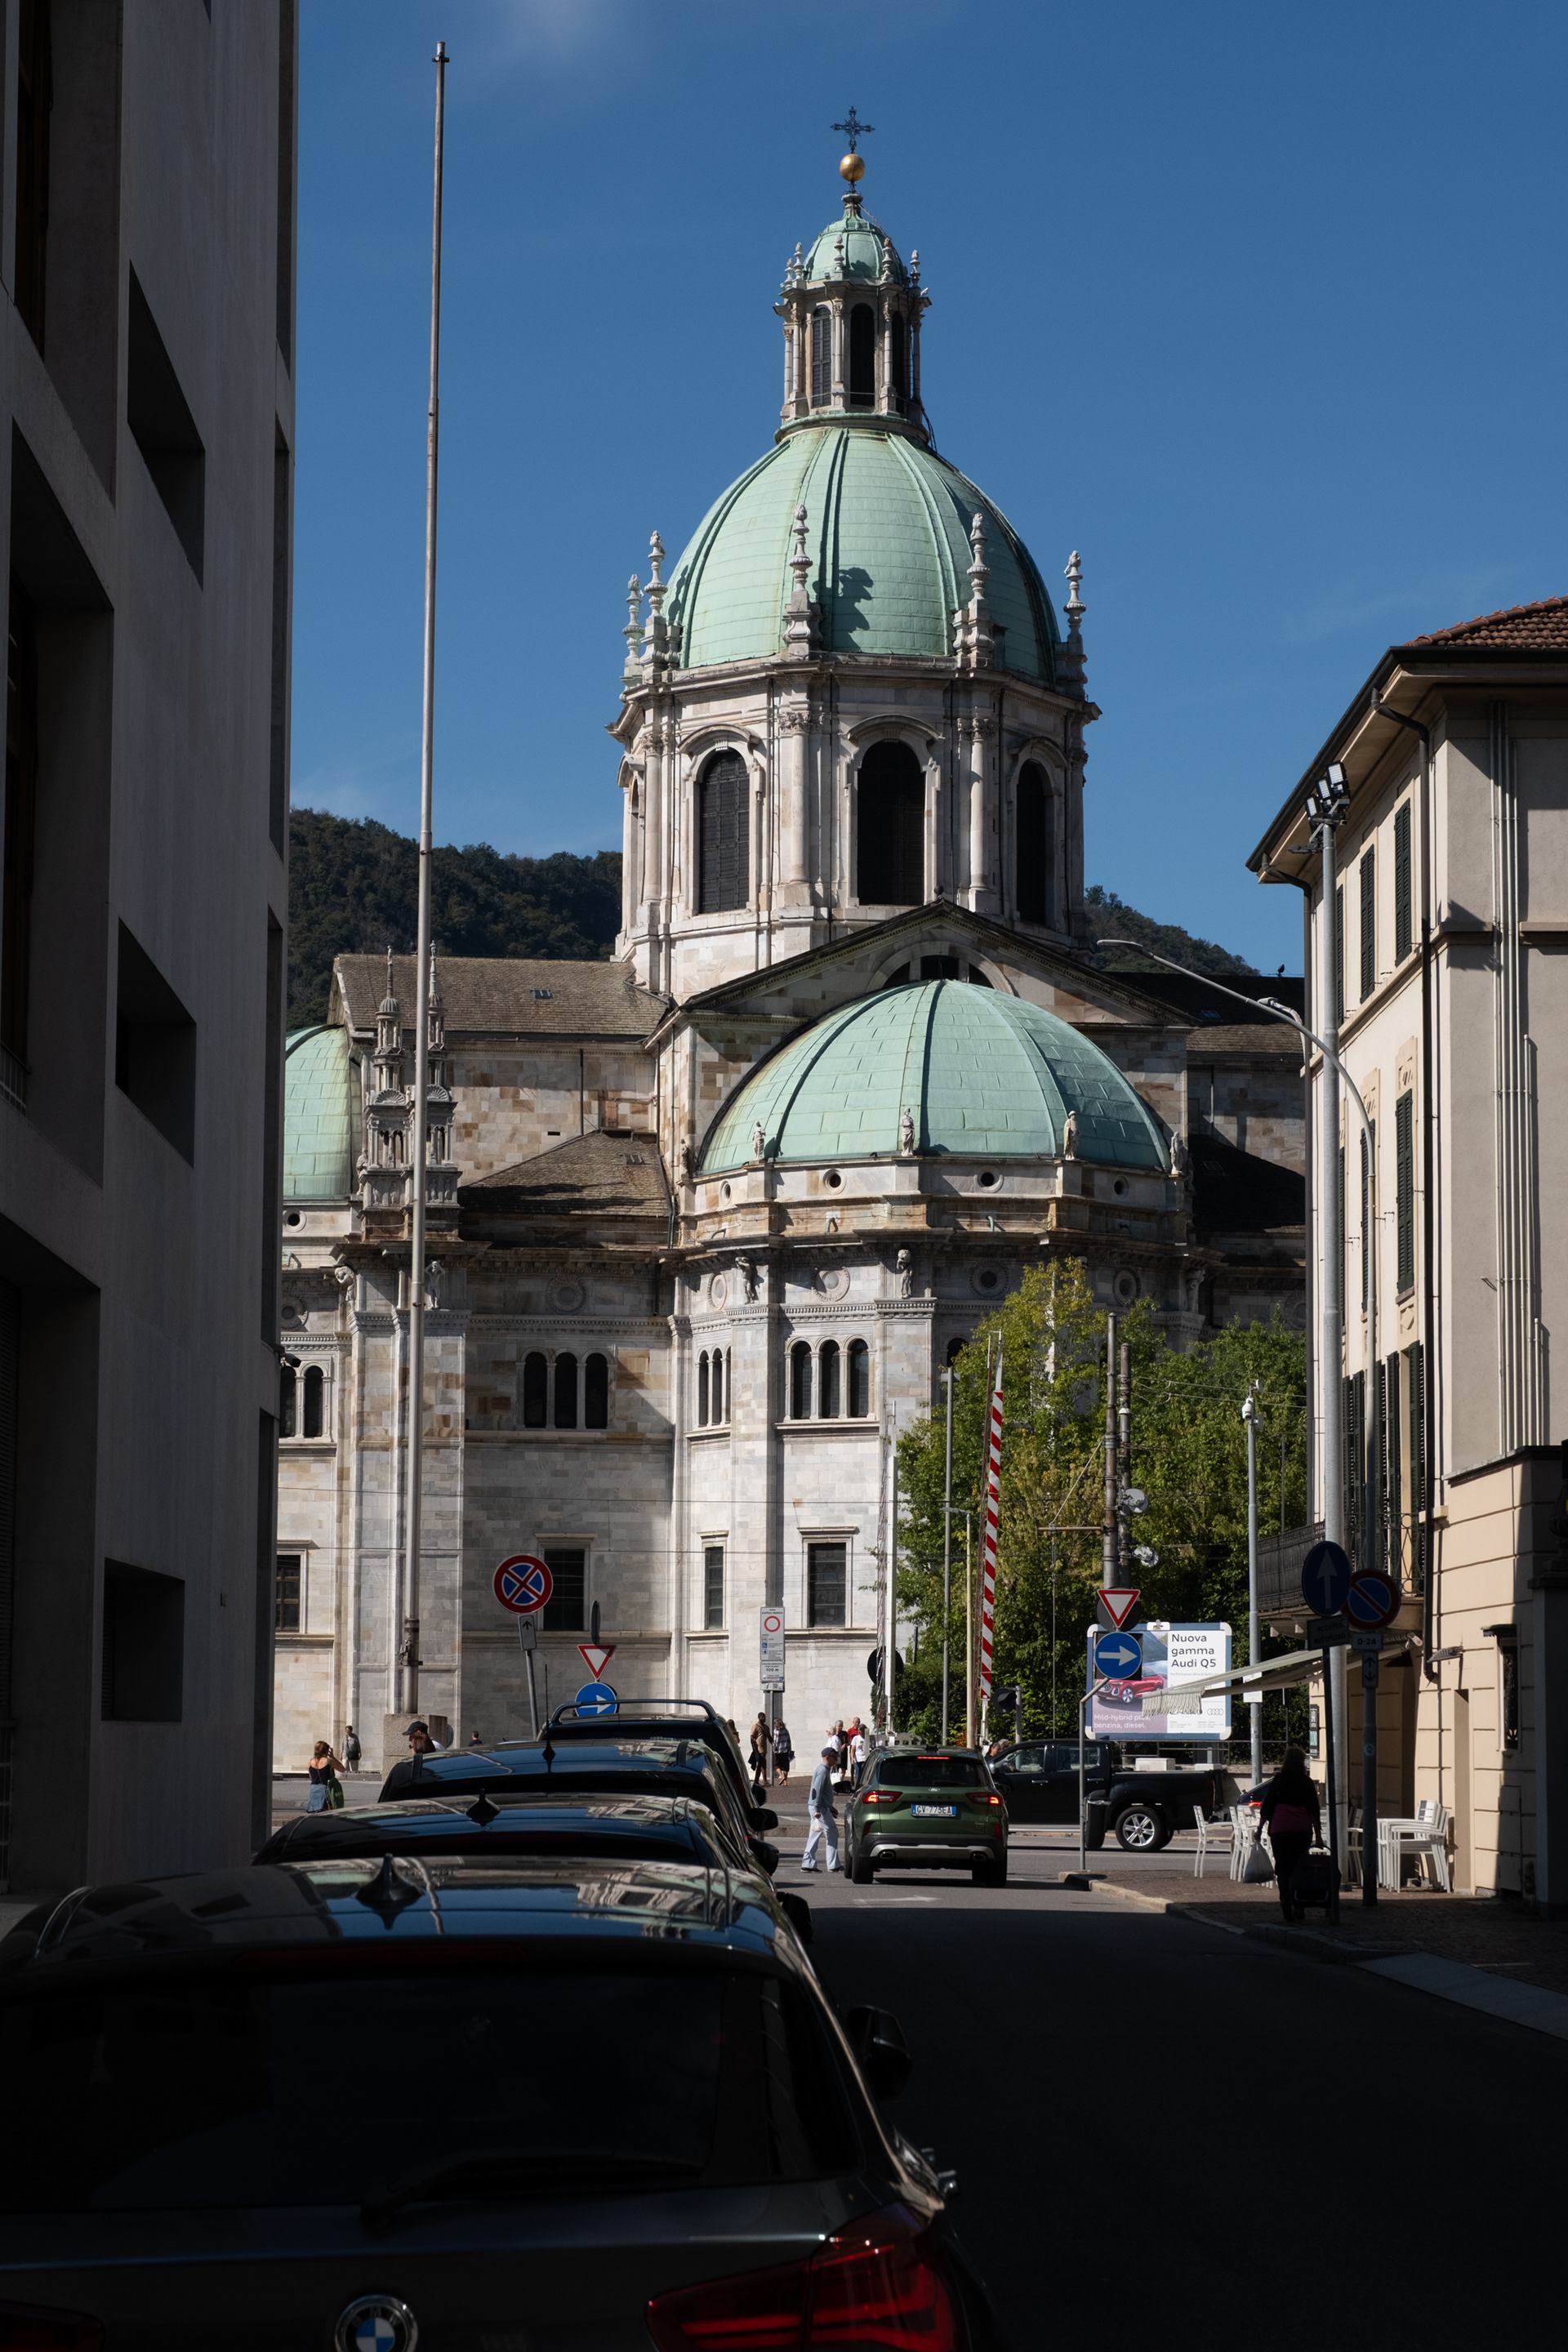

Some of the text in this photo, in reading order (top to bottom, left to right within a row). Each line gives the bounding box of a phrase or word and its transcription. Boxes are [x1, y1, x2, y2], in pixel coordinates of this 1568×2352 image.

[1316, 1623, 1344, 1632] eccetto
[1171, 1633, 1207, 1642] Nuova
[1313, 1632, 1346, 1644] autorizzati
[1171, 1648, 1214, 1657] gamma
[1171, 1659, 1217, 1668] Audi Q5
[1094, 1714, 1133, 1722] Mild-hybrid
